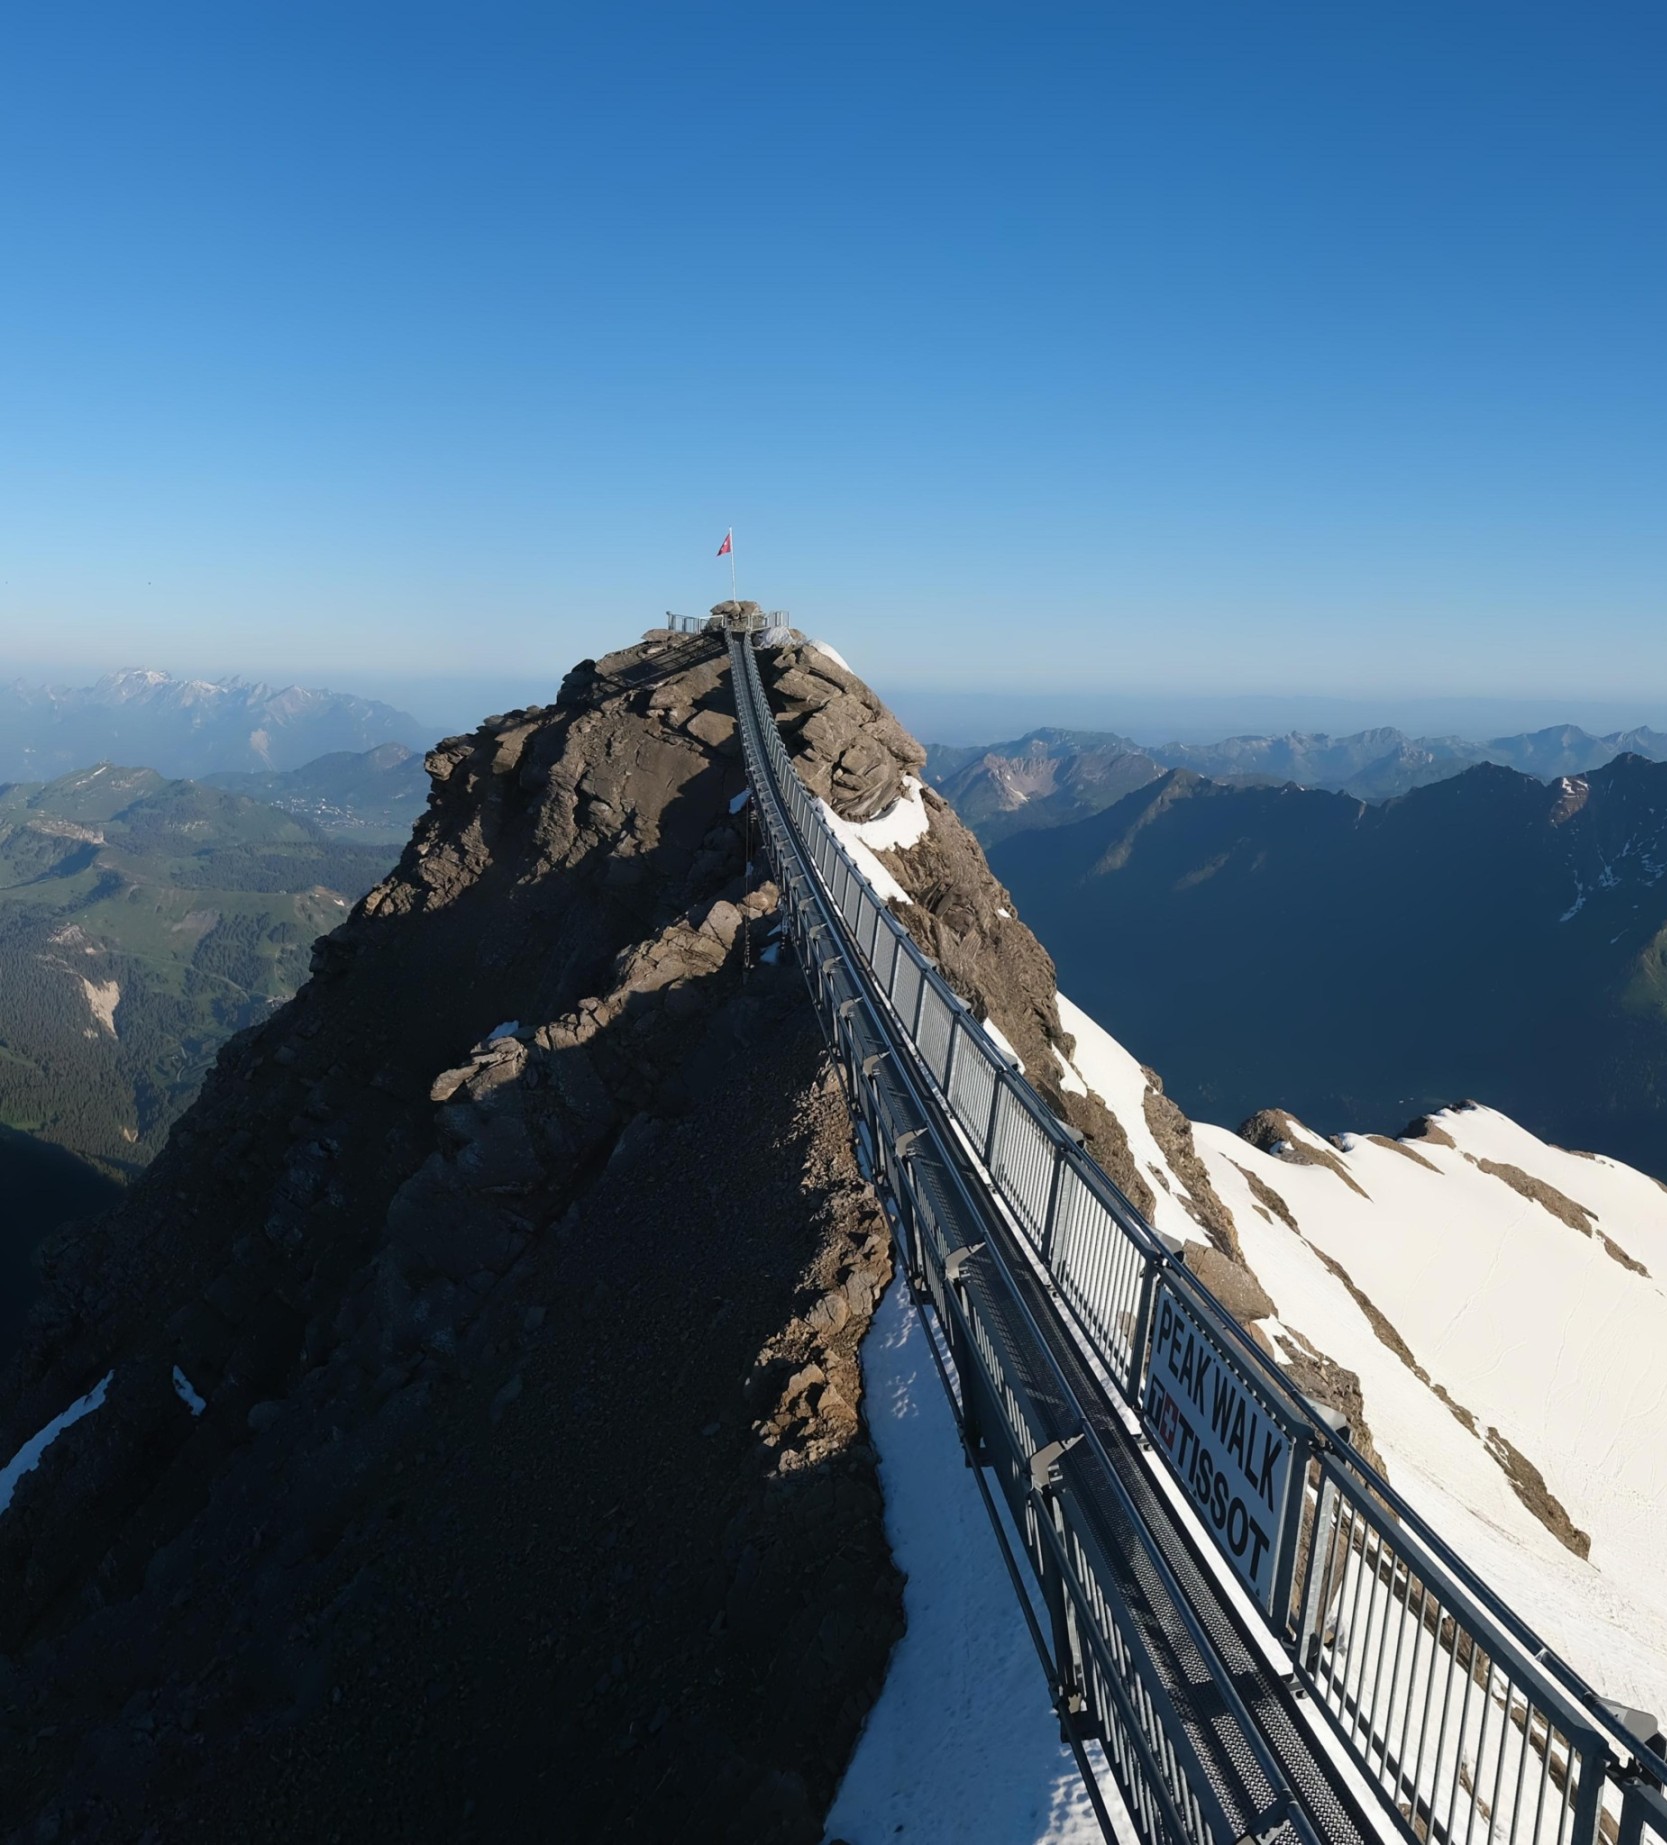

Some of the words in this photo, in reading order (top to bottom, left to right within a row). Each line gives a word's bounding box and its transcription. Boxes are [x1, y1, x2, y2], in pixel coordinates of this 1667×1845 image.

[1157, 1299, 1212, 1417] PEAK
[1211, 1365, 1283, 1514] WALK
[1177, 1411, 1271, 1583] TISSOT
